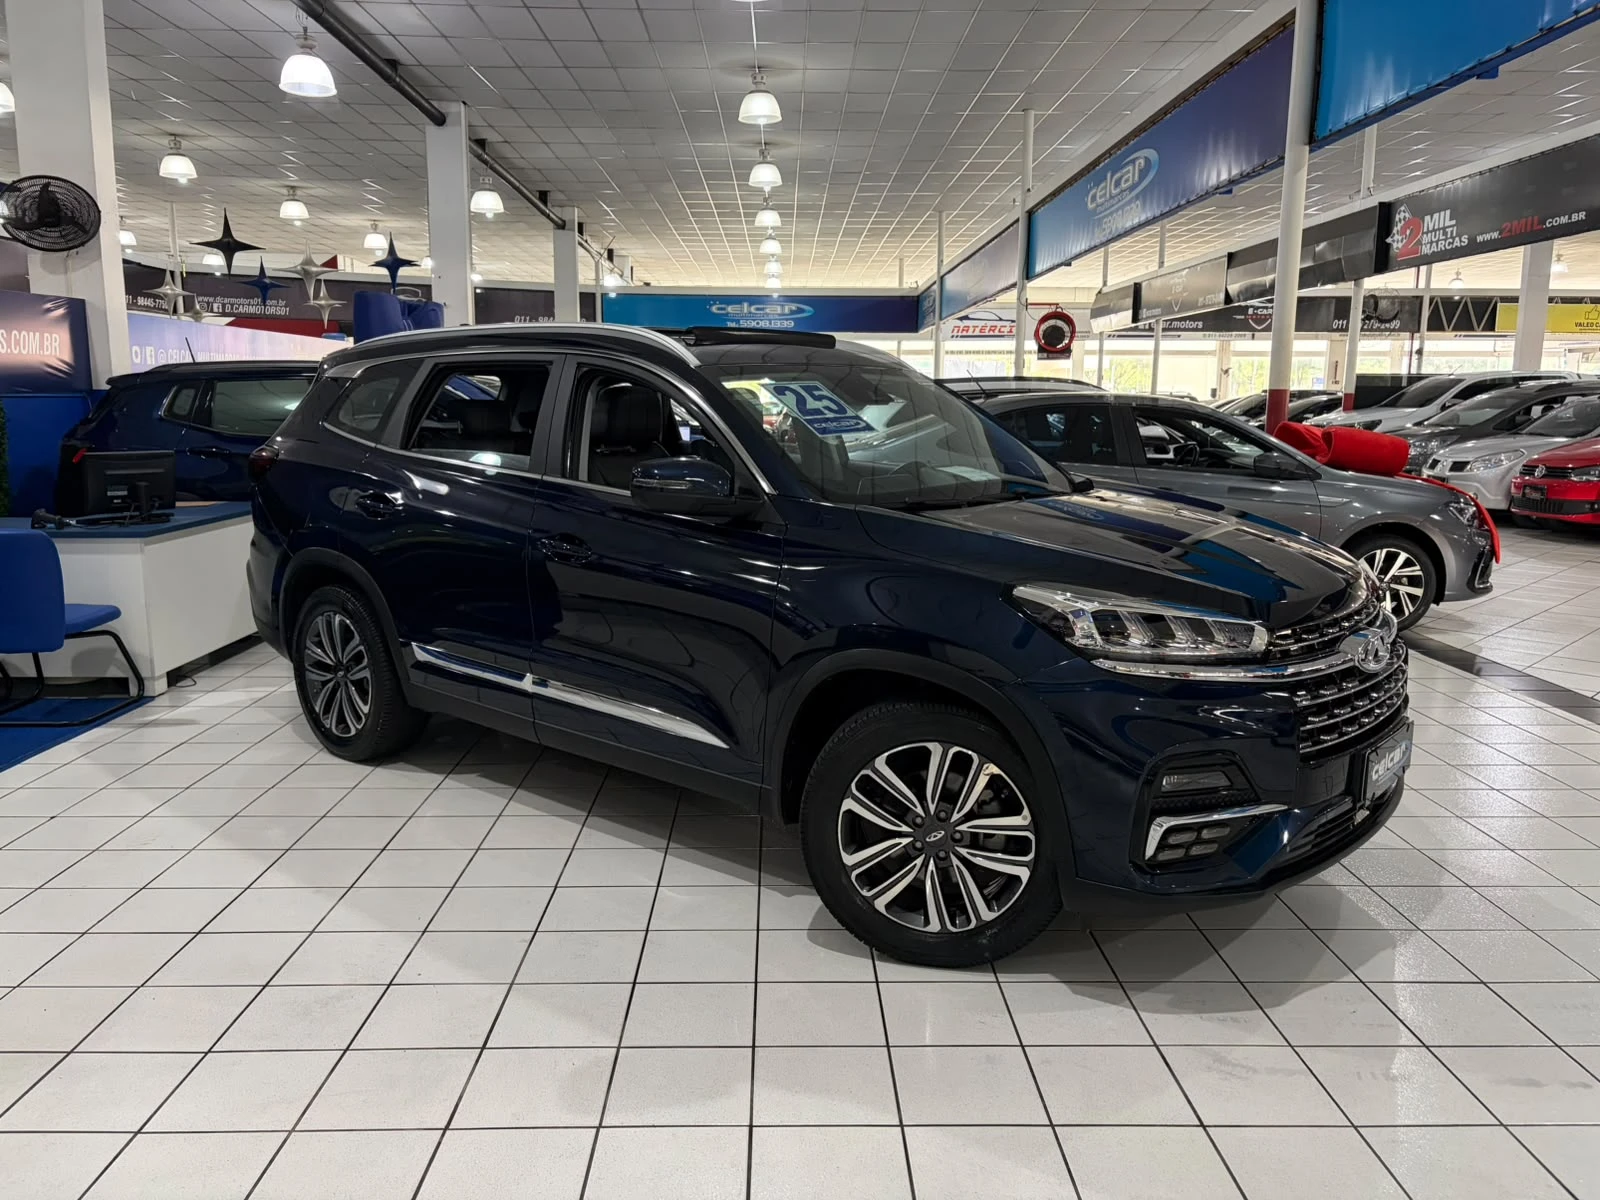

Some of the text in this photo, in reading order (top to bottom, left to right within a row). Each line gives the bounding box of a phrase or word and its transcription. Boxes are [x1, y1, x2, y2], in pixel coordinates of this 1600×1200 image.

[1087, 156, 1146, 211] celcar
[1423, 209, 1456, 232] MIL
[1476, 211, 1587, 243] www.2MIL.COM.BR
[1395, 216, 1424, 261] 2
[1421, 234, 1469, 256] MARCAS
[1422, 226, 1457, 244] MULTI
[198, 295, 286, 306] www.dcarmotors01.om.br
[711, 302, 798, 314] celcar
[951, 323, 1016, 335] NATÉRCI
[1332, 319, 1347, 329] 011
[0, 329, 60, 356] S.COM.BR
[773, 384, 848, 416] 25
[1372, 741, 1406, 781] celcar
